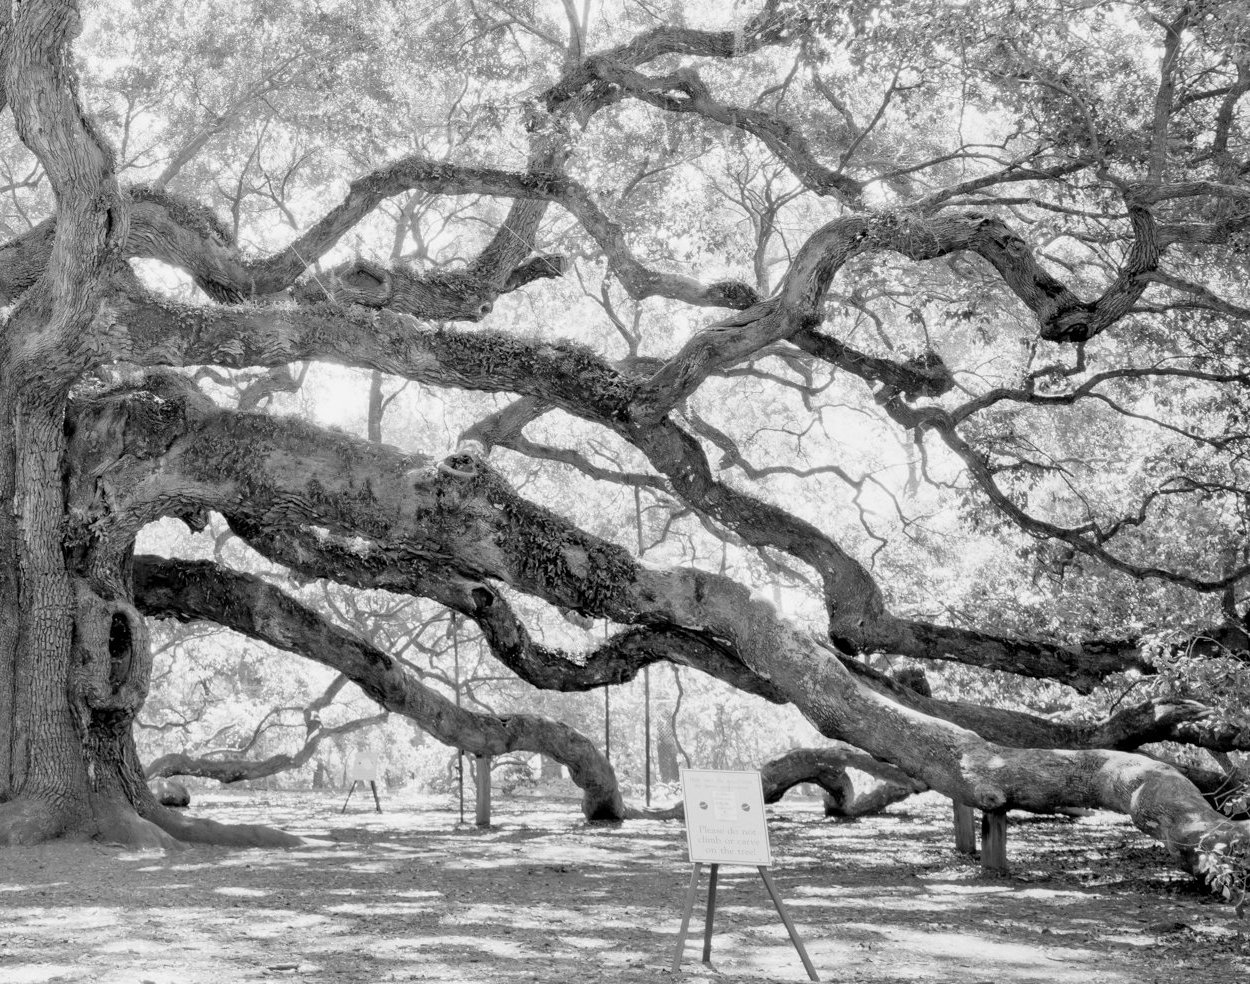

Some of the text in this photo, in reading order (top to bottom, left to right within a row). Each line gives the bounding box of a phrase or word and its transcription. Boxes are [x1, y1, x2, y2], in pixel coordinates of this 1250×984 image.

[699, 825, 724, 834] Please
[727, 826, 739, 835] do
[697, 835, 721, 844] climb
[720, 846, 734, 855] the
